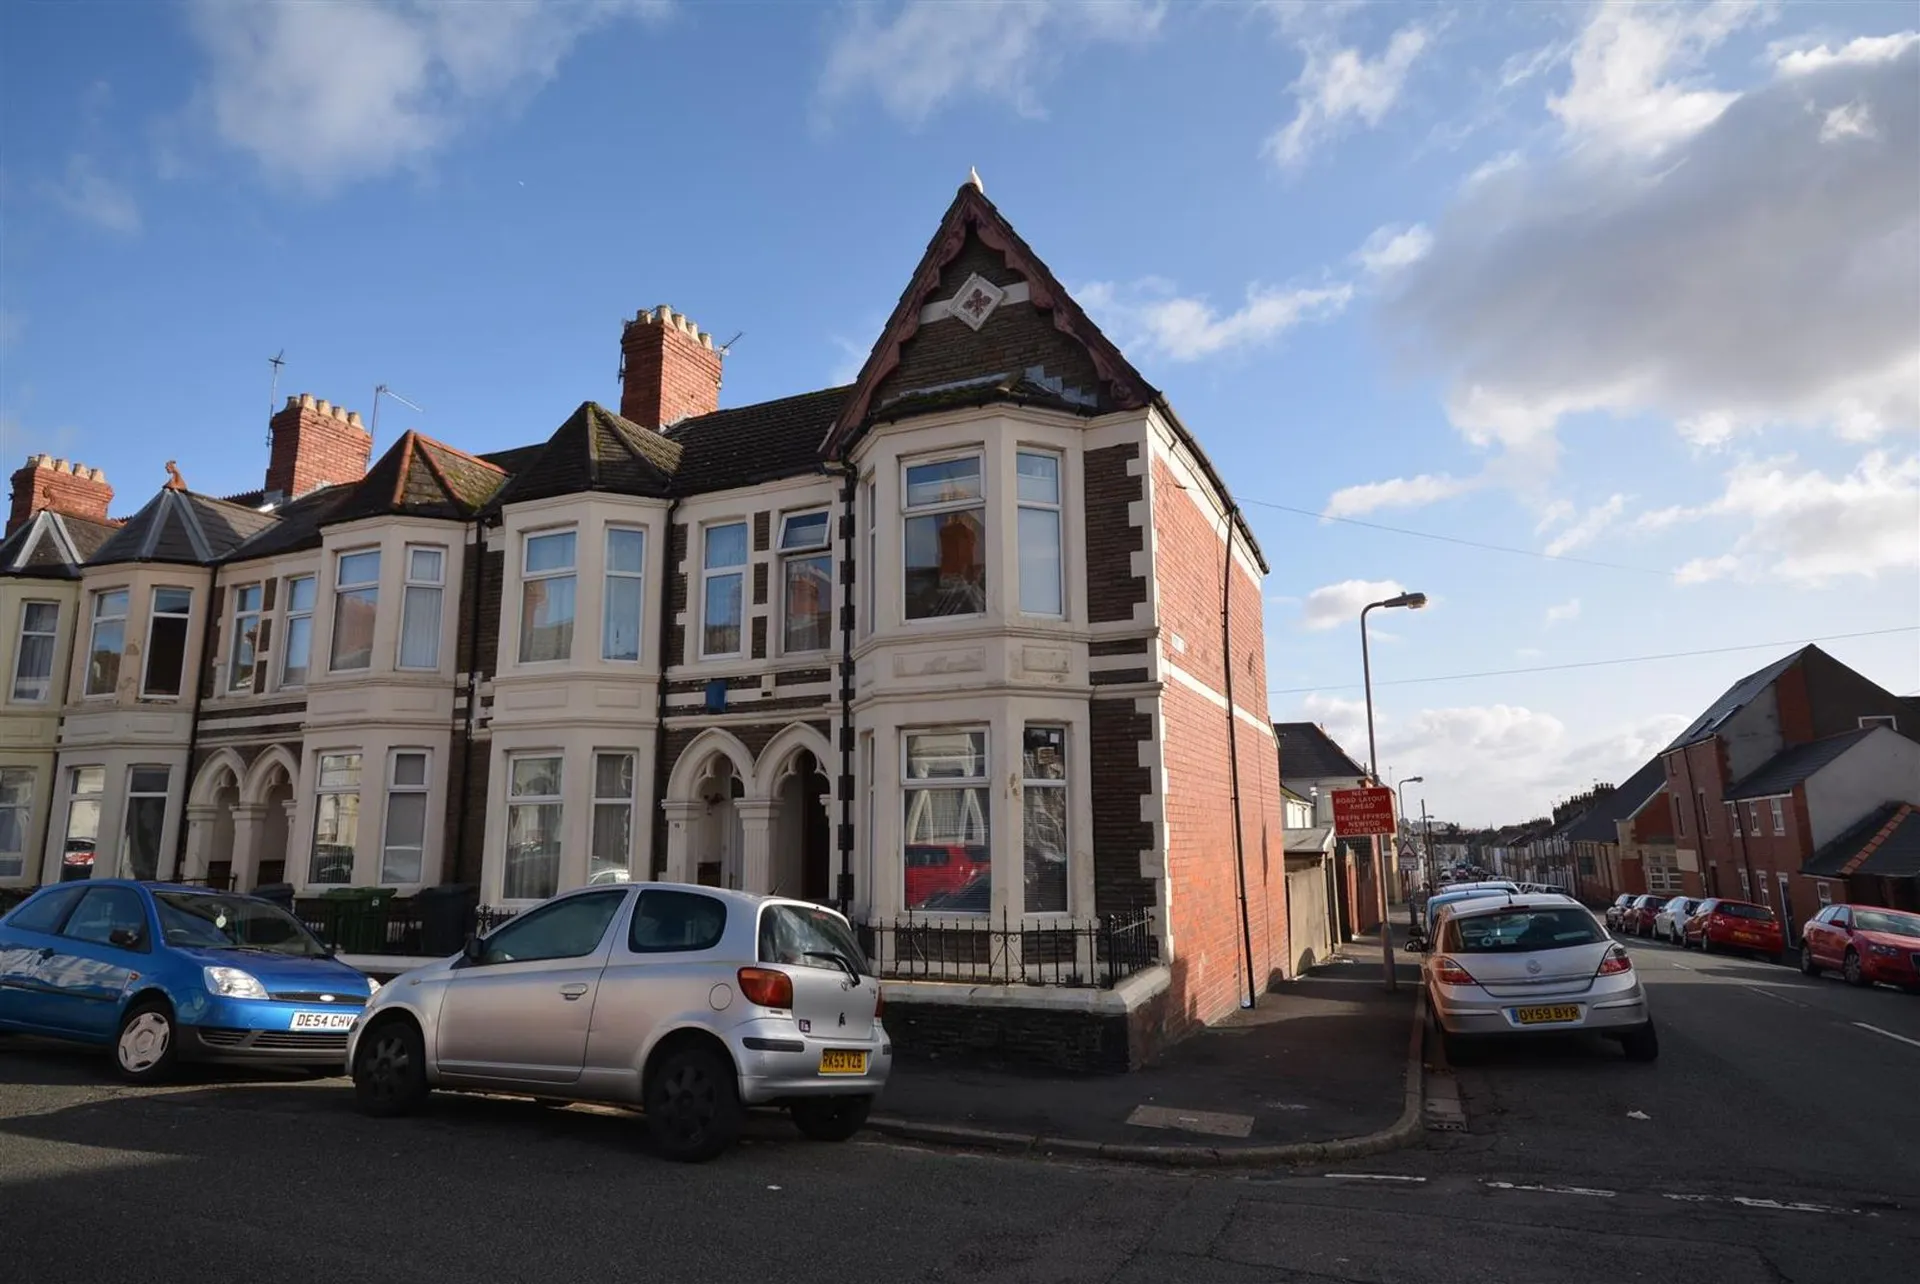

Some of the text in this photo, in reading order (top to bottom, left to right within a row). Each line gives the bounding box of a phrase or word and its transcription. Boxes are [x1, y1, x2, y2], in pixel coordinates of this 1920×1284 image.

[1359, 795, 1386, 803] LAYOUT
[1350, 802, 1375, 810] AHEAD
[297, 1014, 353, 1027] DE54 CHV
